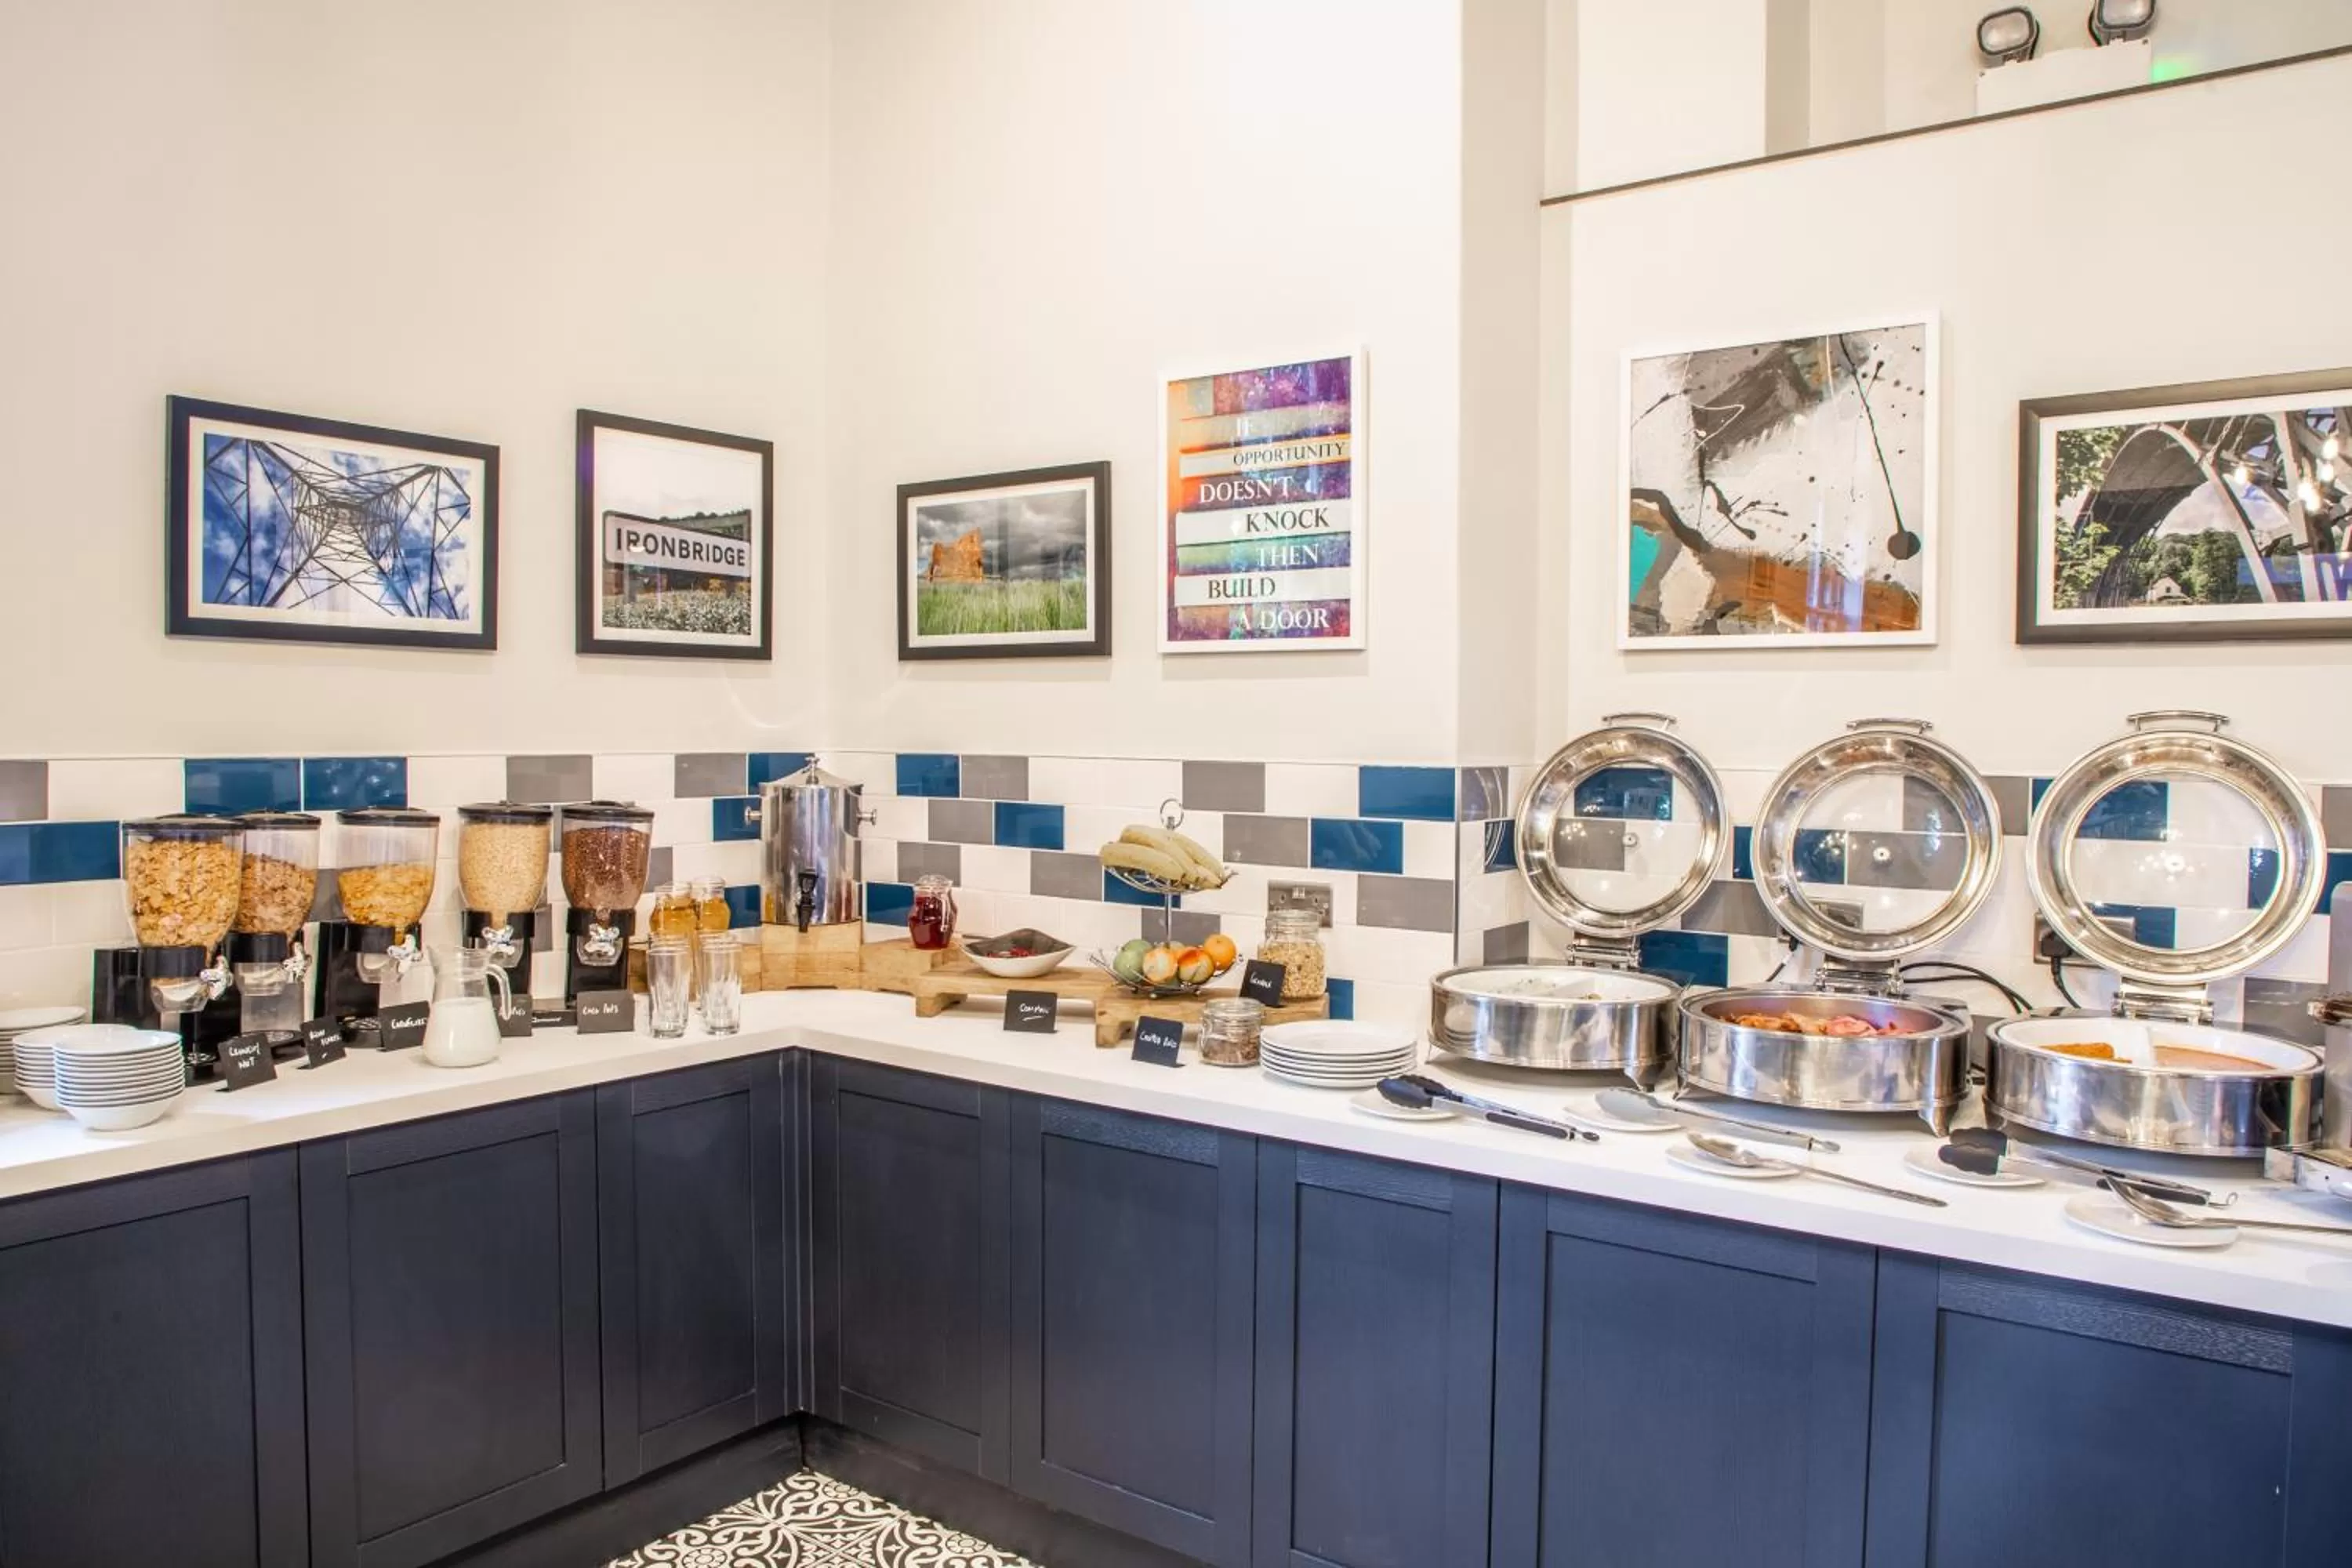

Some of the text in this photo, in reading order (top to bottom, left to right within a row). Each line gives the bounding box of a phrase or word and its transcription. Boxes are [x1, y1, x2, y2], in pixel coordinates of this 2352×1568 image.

[1232, 441, 1346, 466] OPPORTUNITY
[1199, 476, 1293, 504] DOESN'T
[1246, 507, 1330, 532] KNOCK
[615, 527, 746, 566] IRONBRIDGE
[1256, 543, 1319, 566] THEN
[1207, 576, 1276, 599] BUILD
[1238, 608, 1330, 630] A DOOR
